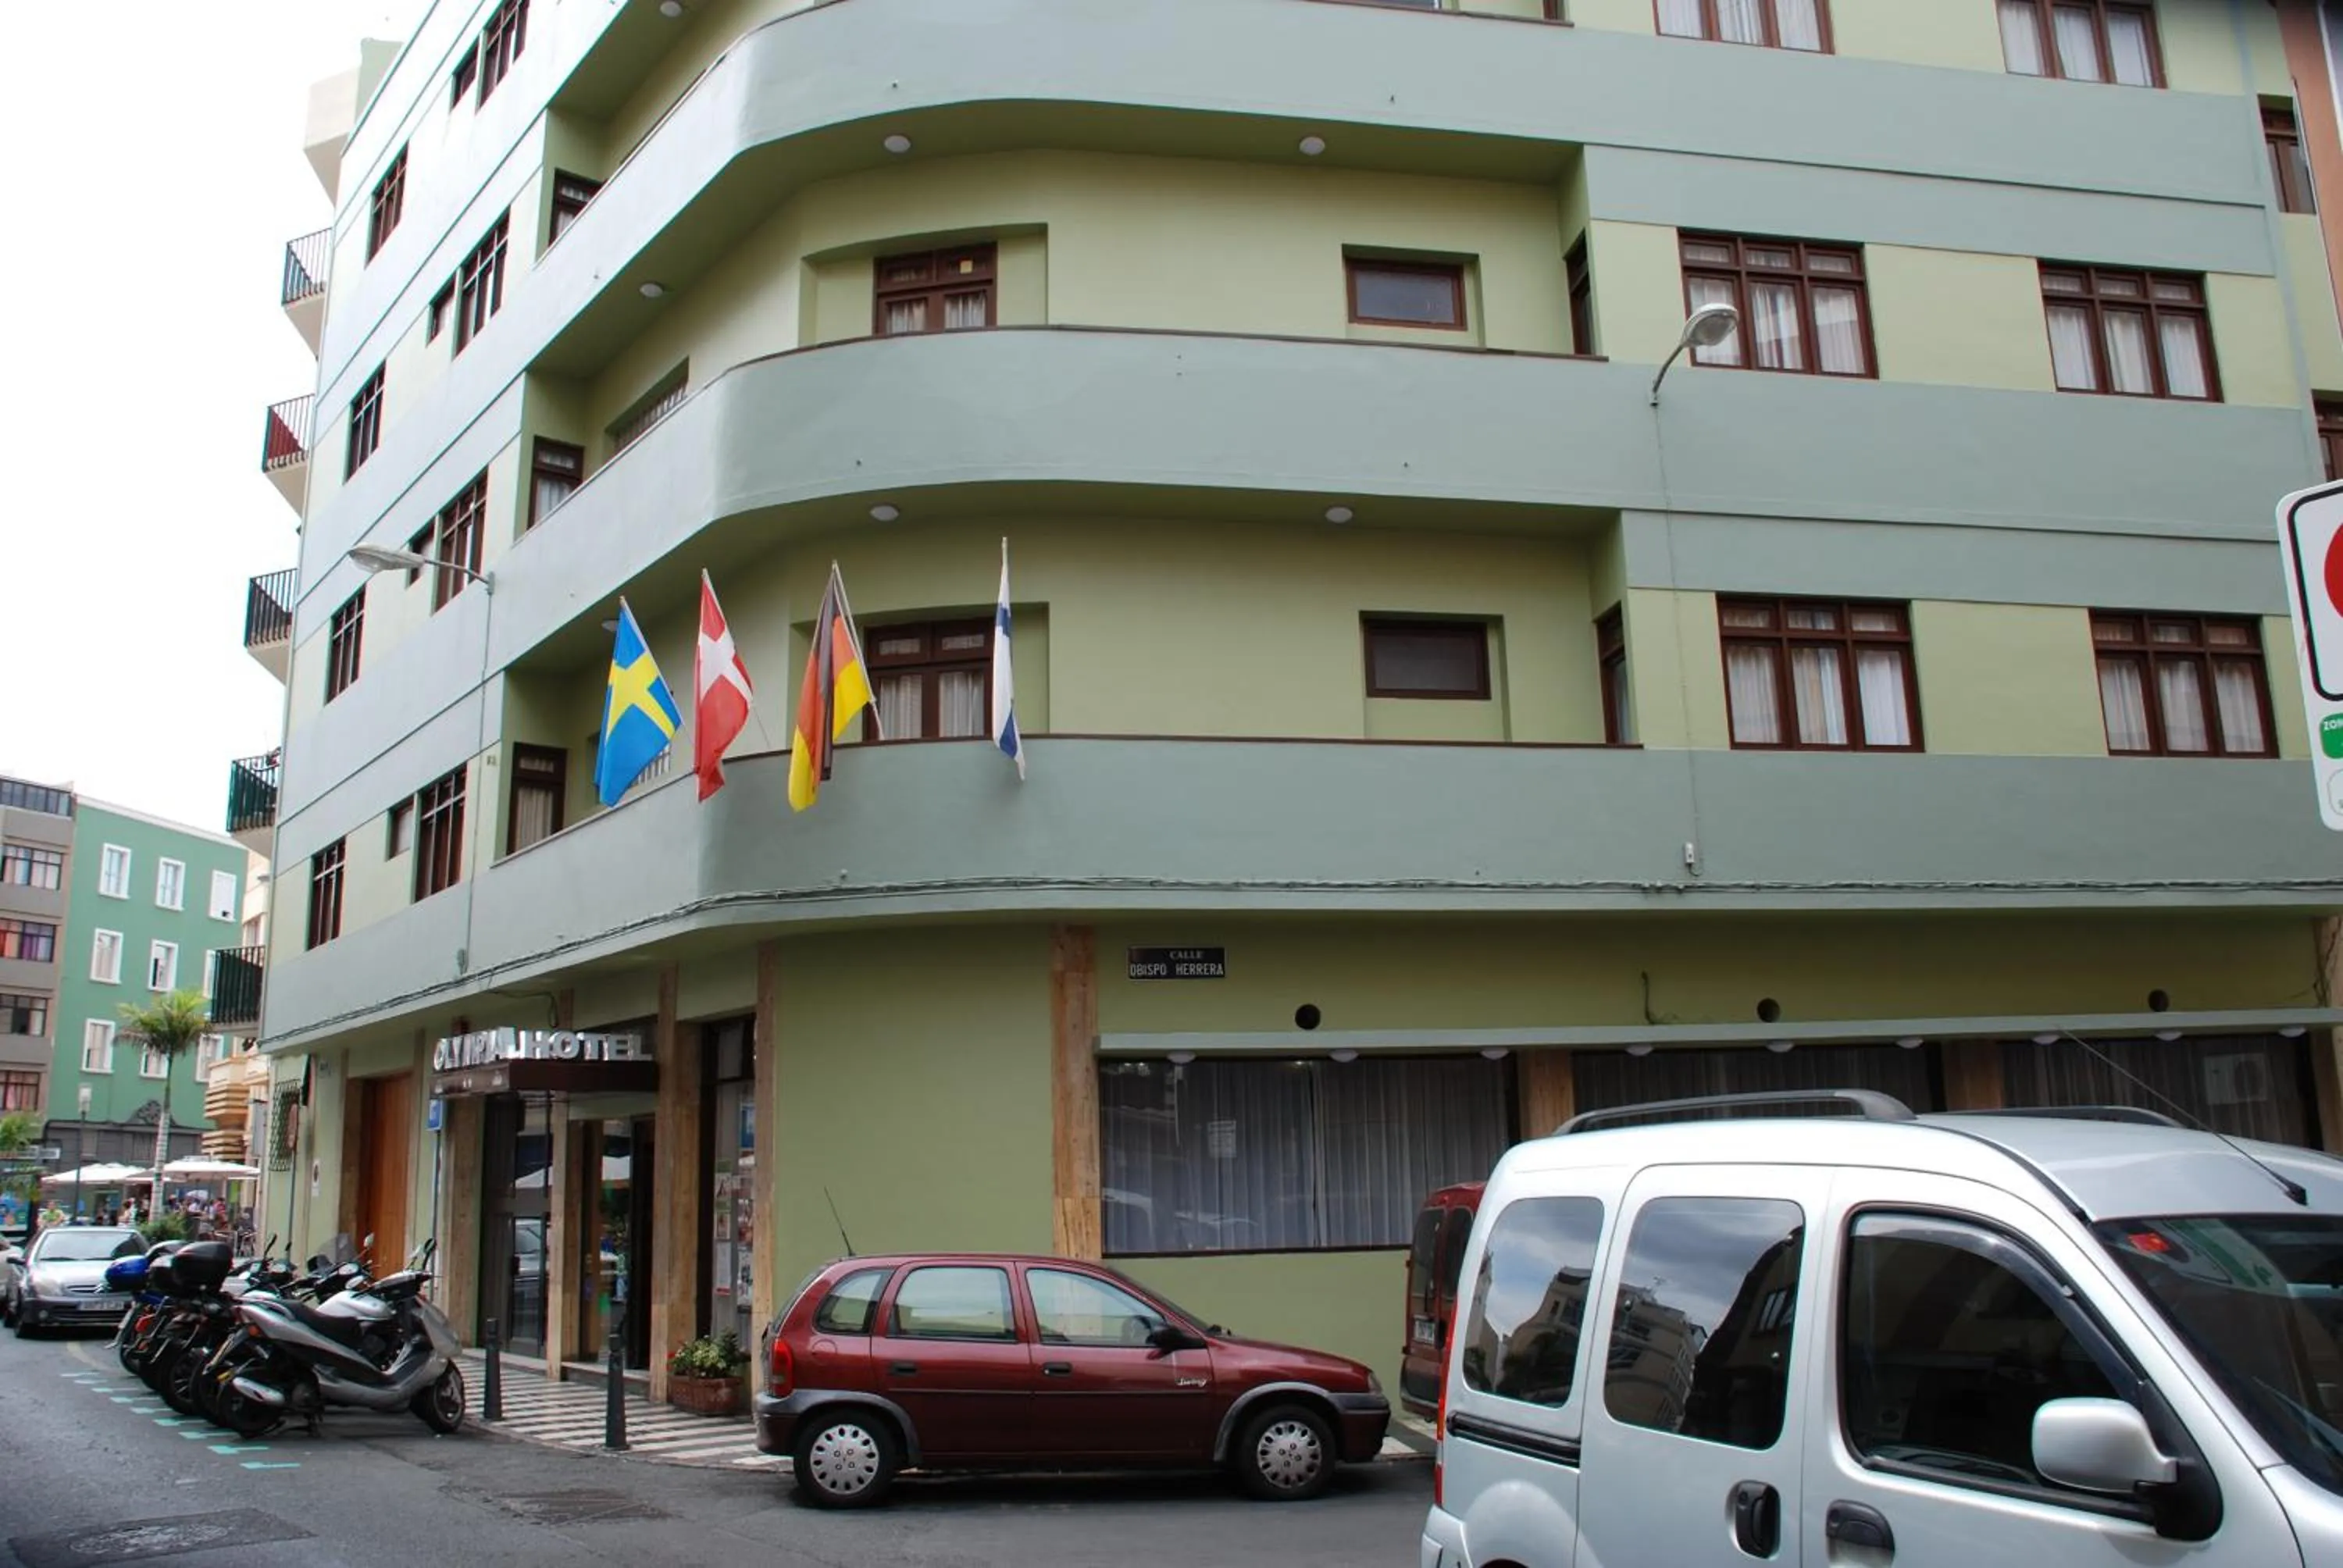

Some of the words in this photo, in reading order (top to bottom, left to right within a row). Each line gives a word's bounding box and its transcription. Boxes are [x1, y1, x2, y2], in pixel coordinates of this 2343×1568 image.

[1169, 950, 1204, 959] CALLE
[1130, 963, 1167, 976] OBISPO
[1175, 963, 1224, 975] HERRERA
[520, 1029, 654, 1060] HOTEL
